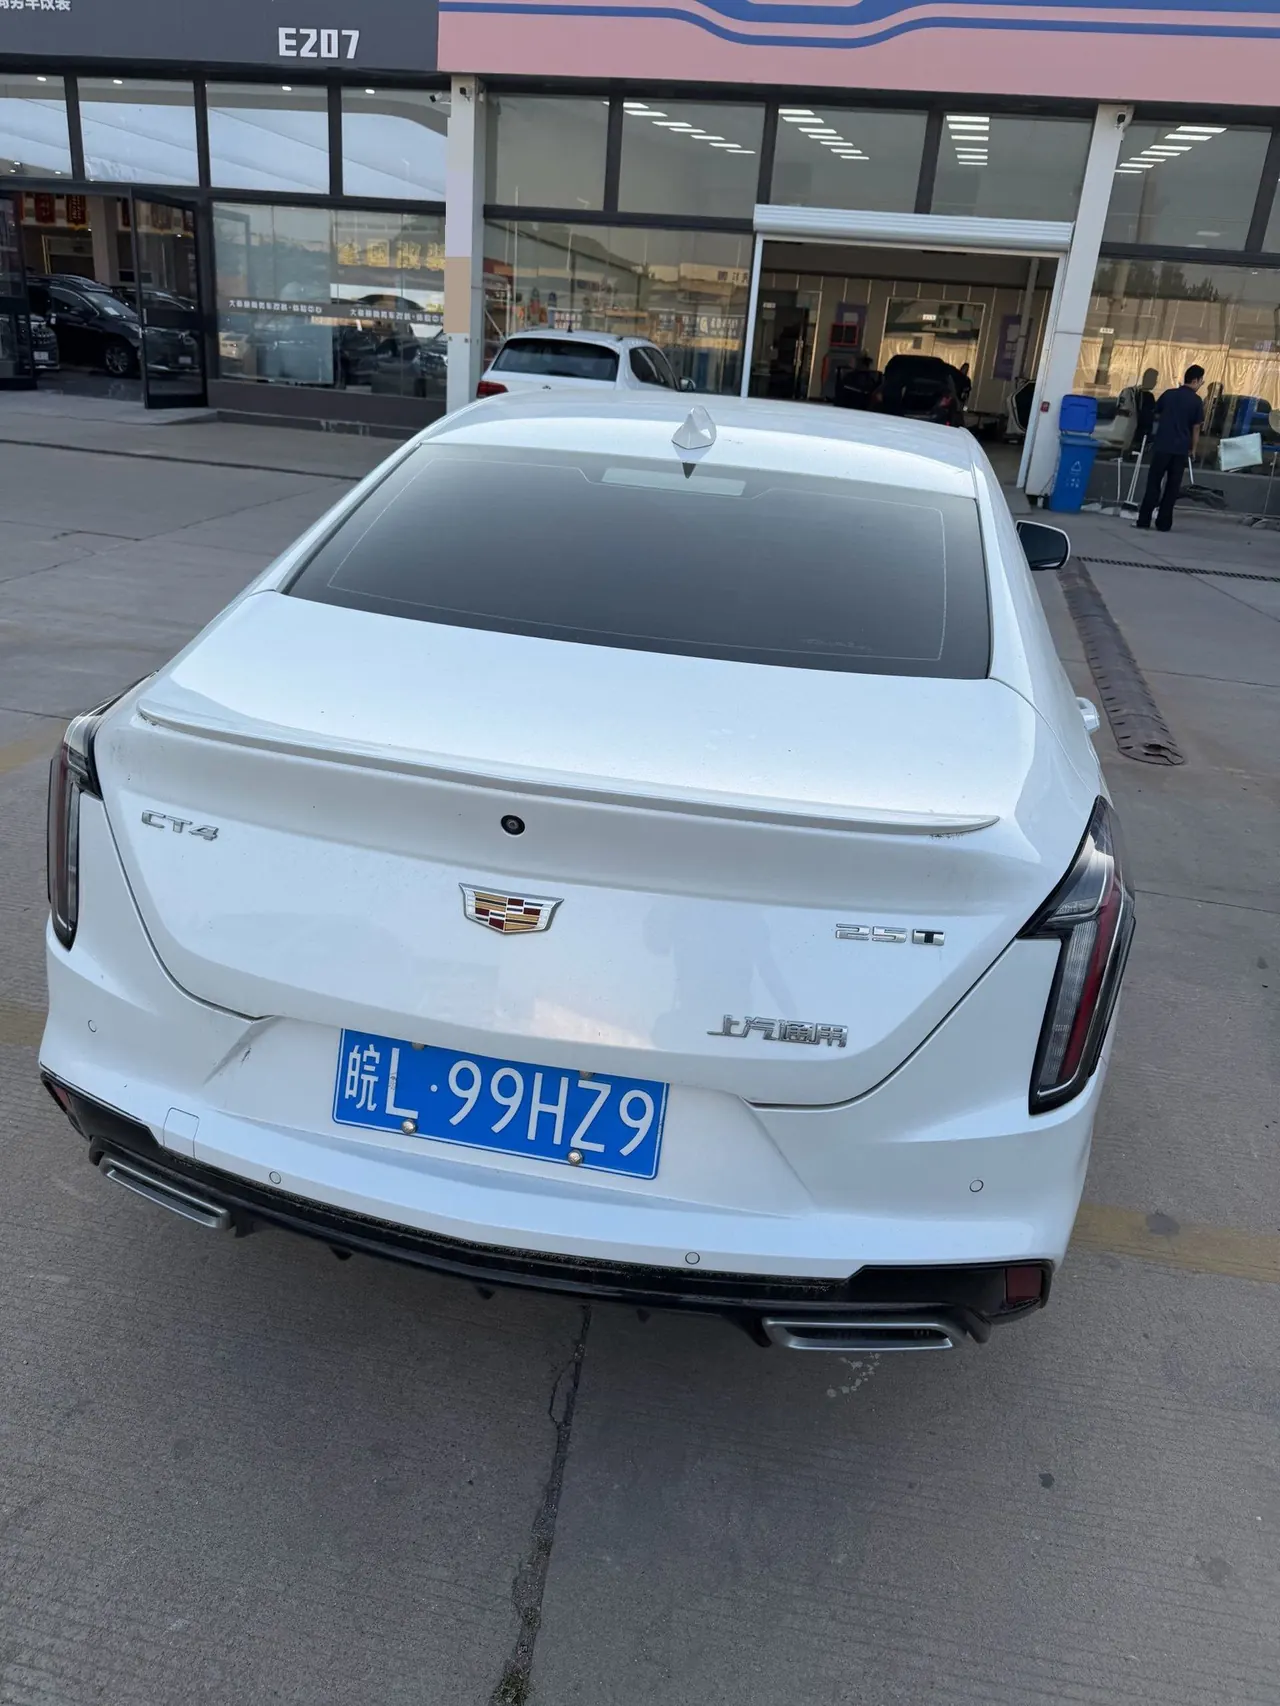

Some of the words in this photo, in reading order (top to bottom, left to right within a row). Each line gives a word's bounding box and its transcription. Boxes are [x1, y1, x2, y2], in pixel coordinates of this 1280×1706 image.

[278, 27, 360, 59] E207
[141, 810, 219, 841] CT4
[835, 923, 945, 946] 25T
[707, 1014, 849, 1048] 上汽通用
[344, 1044, 655, 1157] 皖L·99HZ9
